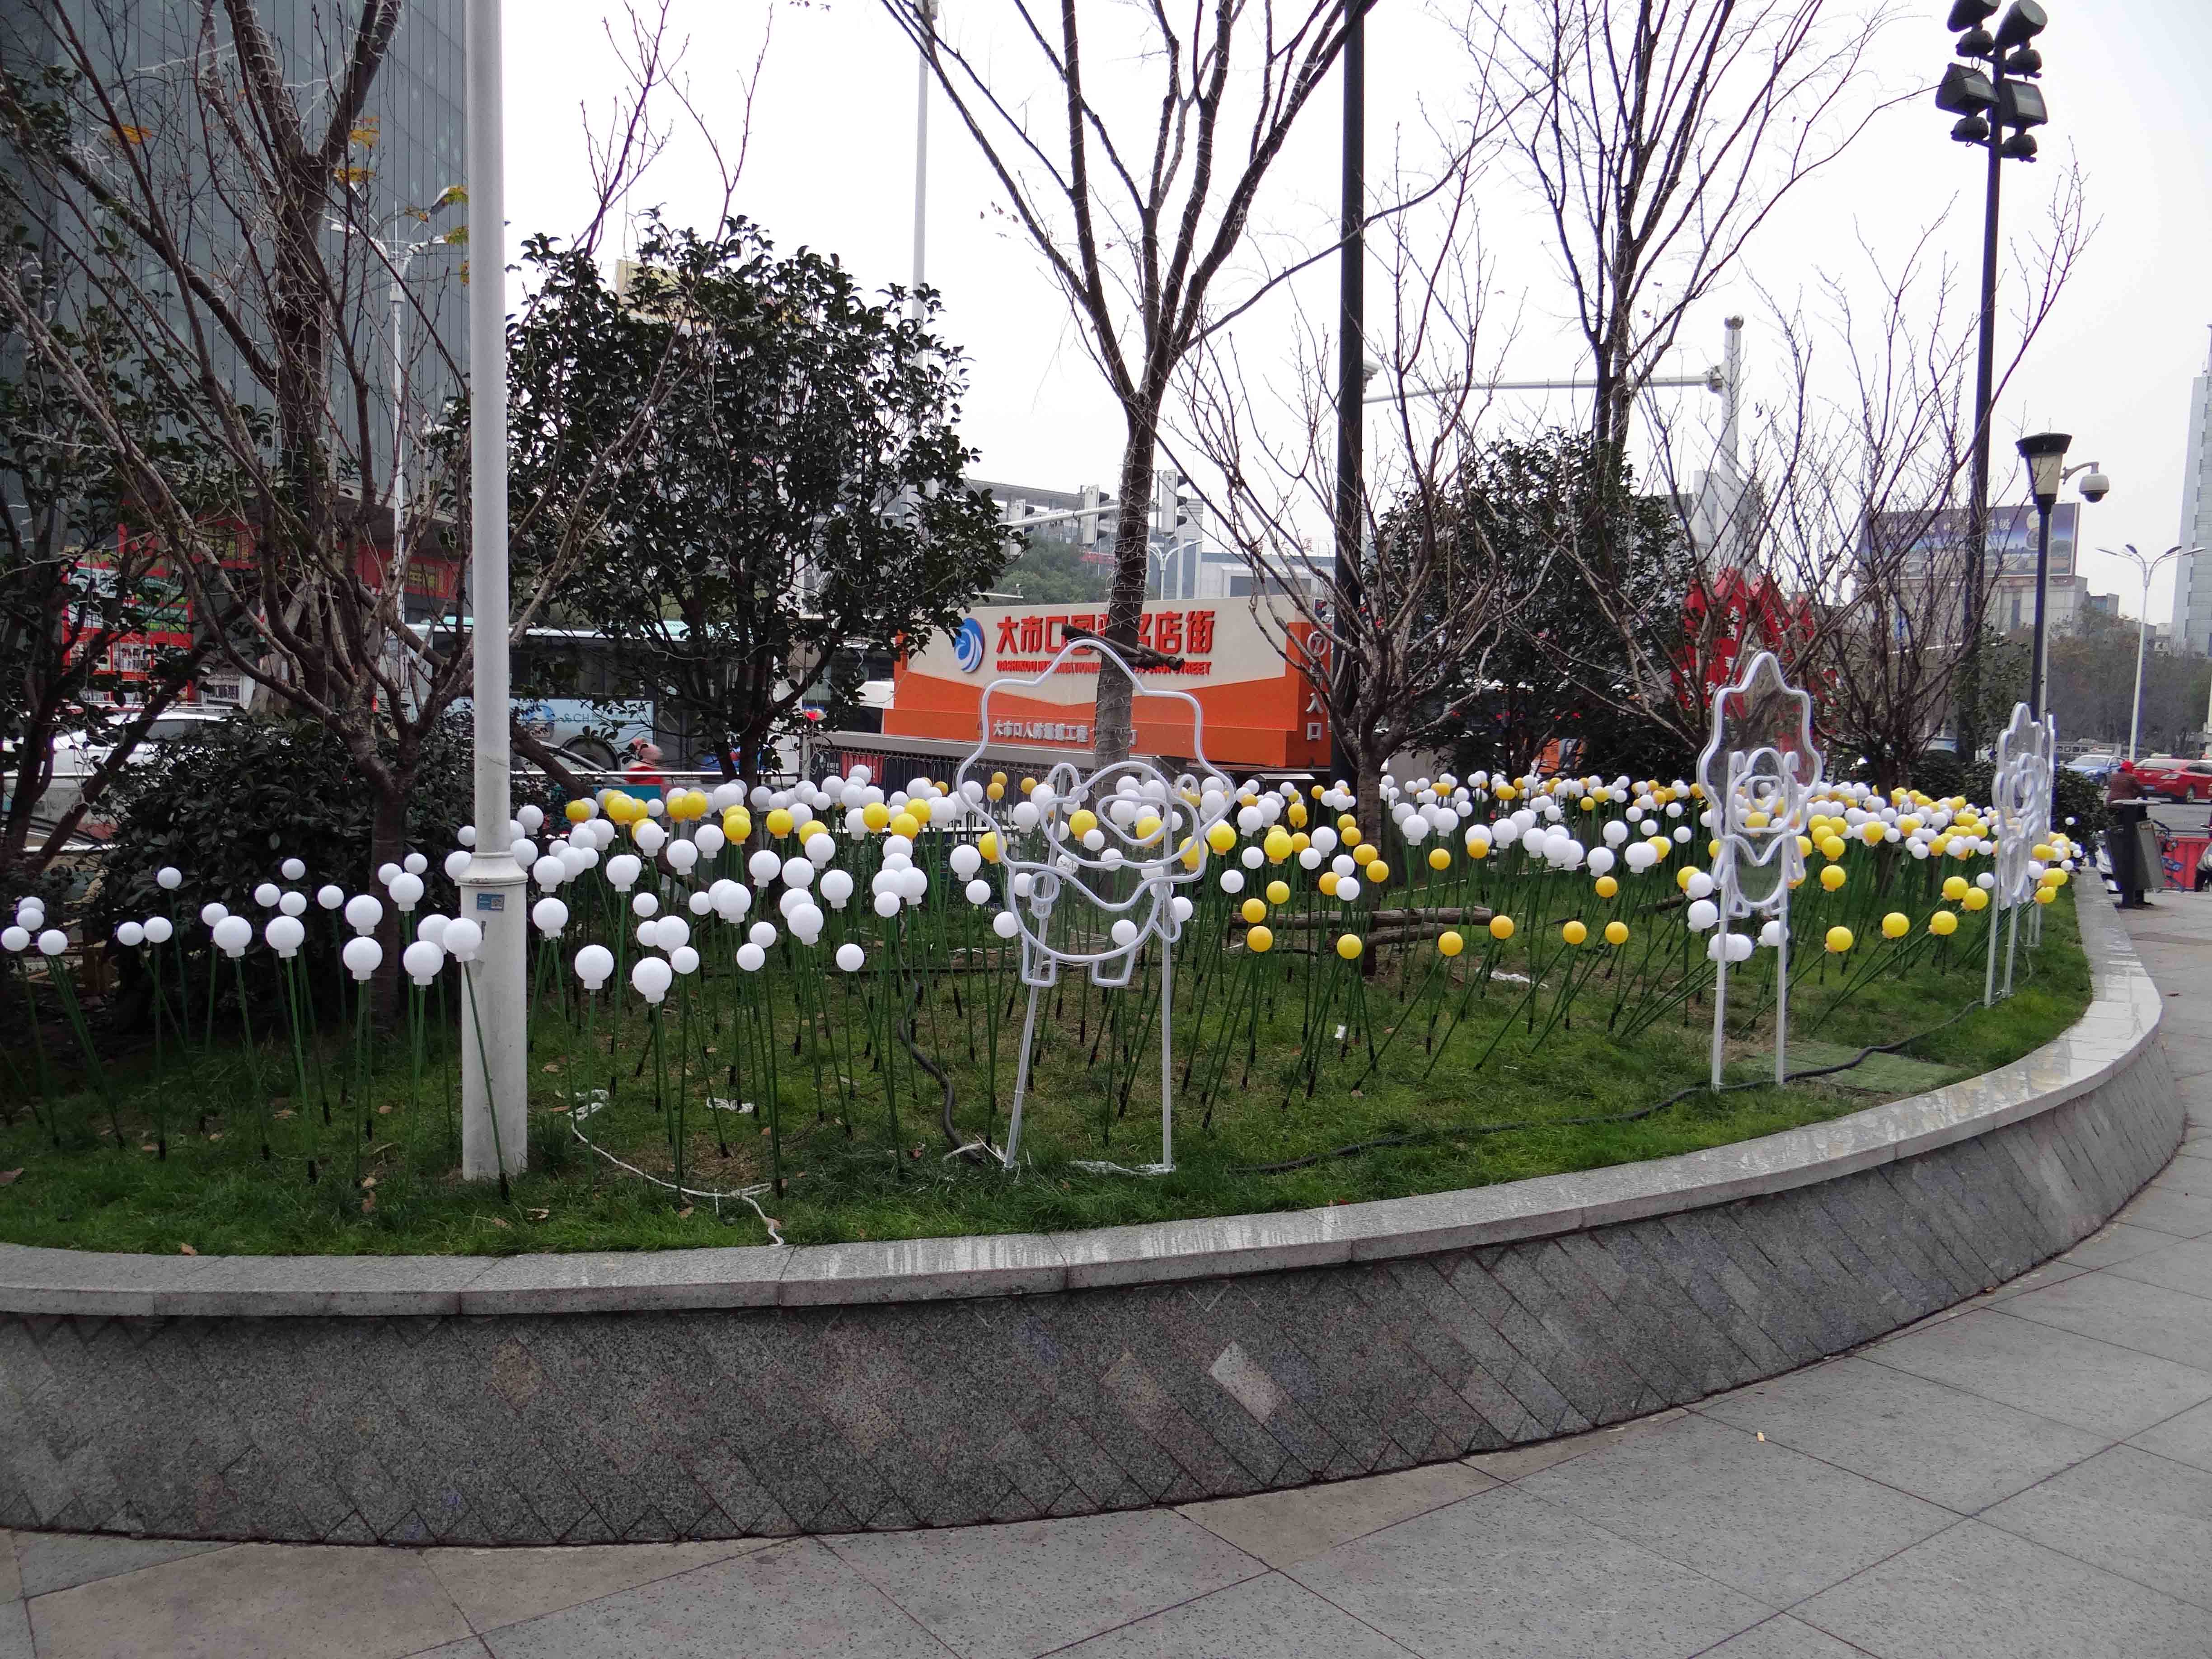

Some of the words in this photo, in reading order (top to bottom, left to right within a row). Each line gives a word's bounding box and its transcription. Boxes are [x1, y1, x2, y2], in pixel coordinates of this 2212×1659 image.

[997, 611, 1214, 655] 大市口国店街
